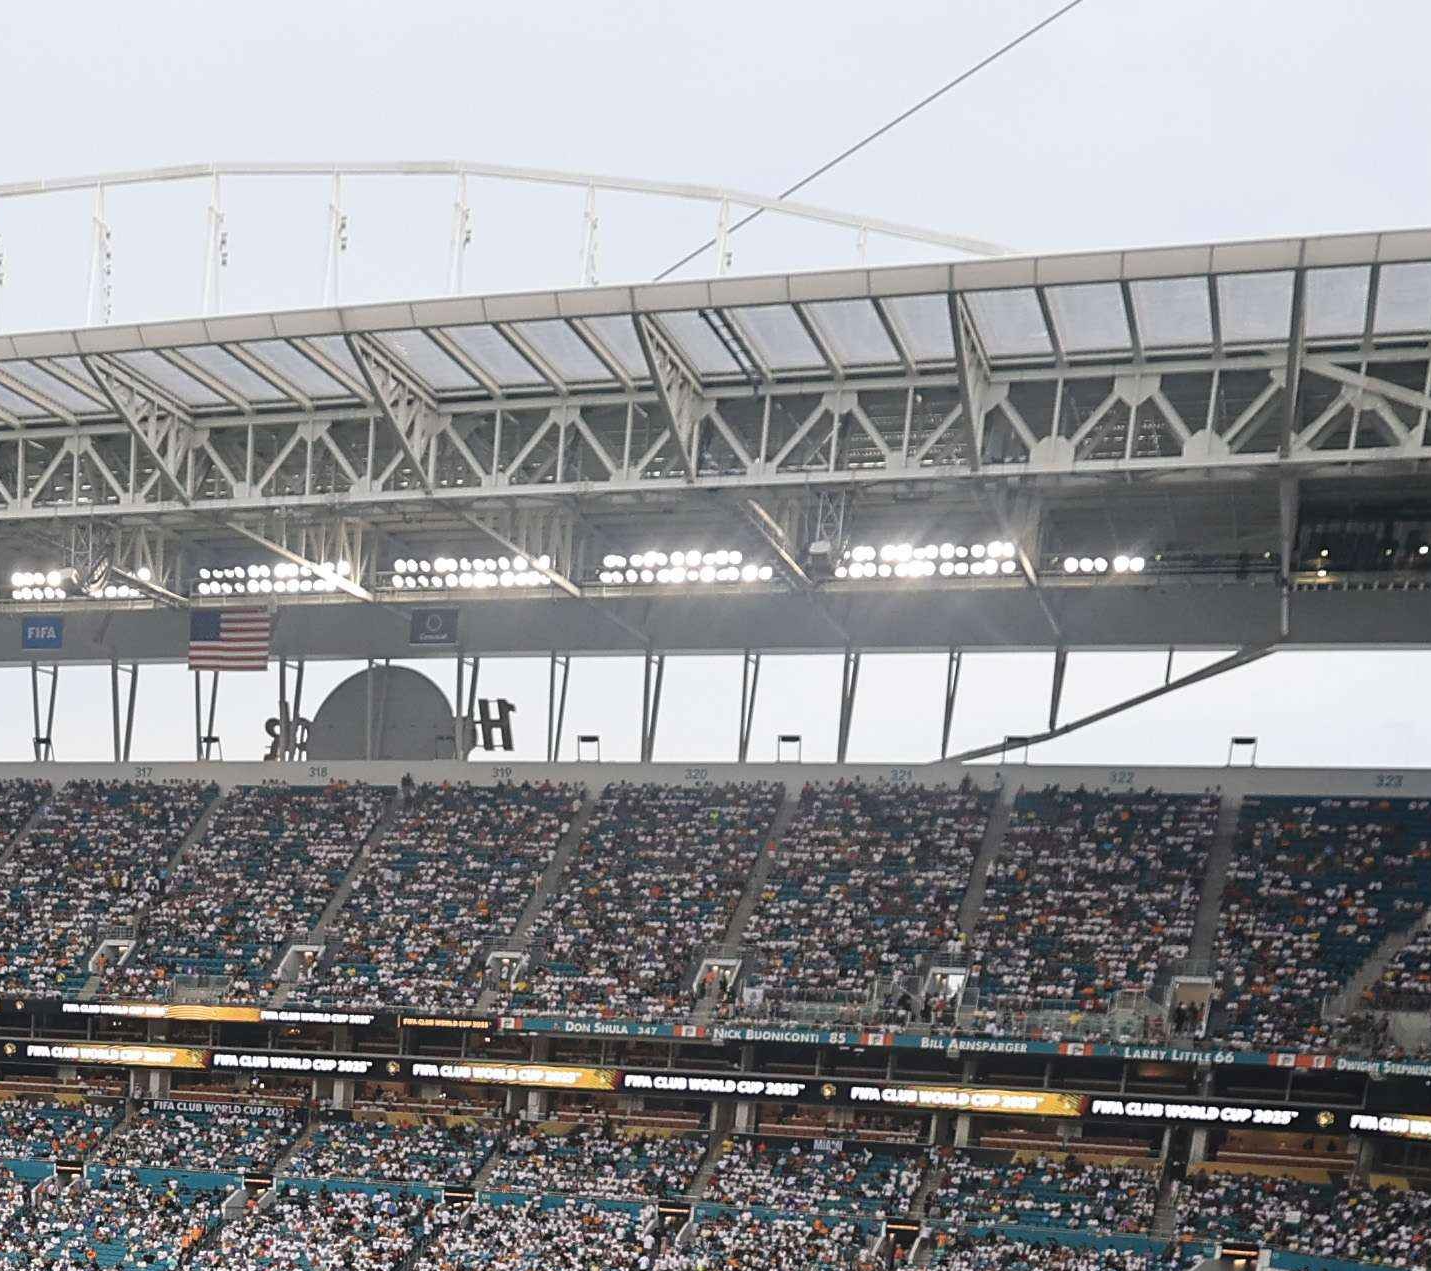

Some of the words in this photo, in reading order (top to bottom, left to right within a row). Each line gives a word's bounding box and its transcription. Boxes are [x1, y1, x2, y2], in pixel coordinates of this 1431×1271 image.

[27, 626, 56, 640] FIFA
[135, 766, 153, 778] 317
[308, 766, 328, 778] 318
[491, 765, 512, 778] 319
[684, 767, 707, 780] 320
[1109, 771, 1134, 785] 322
[565, 1021, 590, 1033] DON
[594, 1022, 628, 1035] SHULA
[637, 1025, 658, 1036] 347
[713, 1029, 741, 1041] NICK
[829, 1033, 846, 1044] 85
[921, 1037, 944, 1049] BILL
[949, 1038, 1027, 1053] ARNSPARGER
[1124, 1046, 1166, 1061] LARRY
[1171, 1047, 1211, 1063] LITTLE
[1215, 1050, 1234, 1064] 66
[1091, 1098, 1124, 1115] FIFA
[1125, 1101, 1165, 1117] CLUB
[1164, 1103, 1220, 1120] WORLD
[1220, 1106, 1252, 1121] CUP
